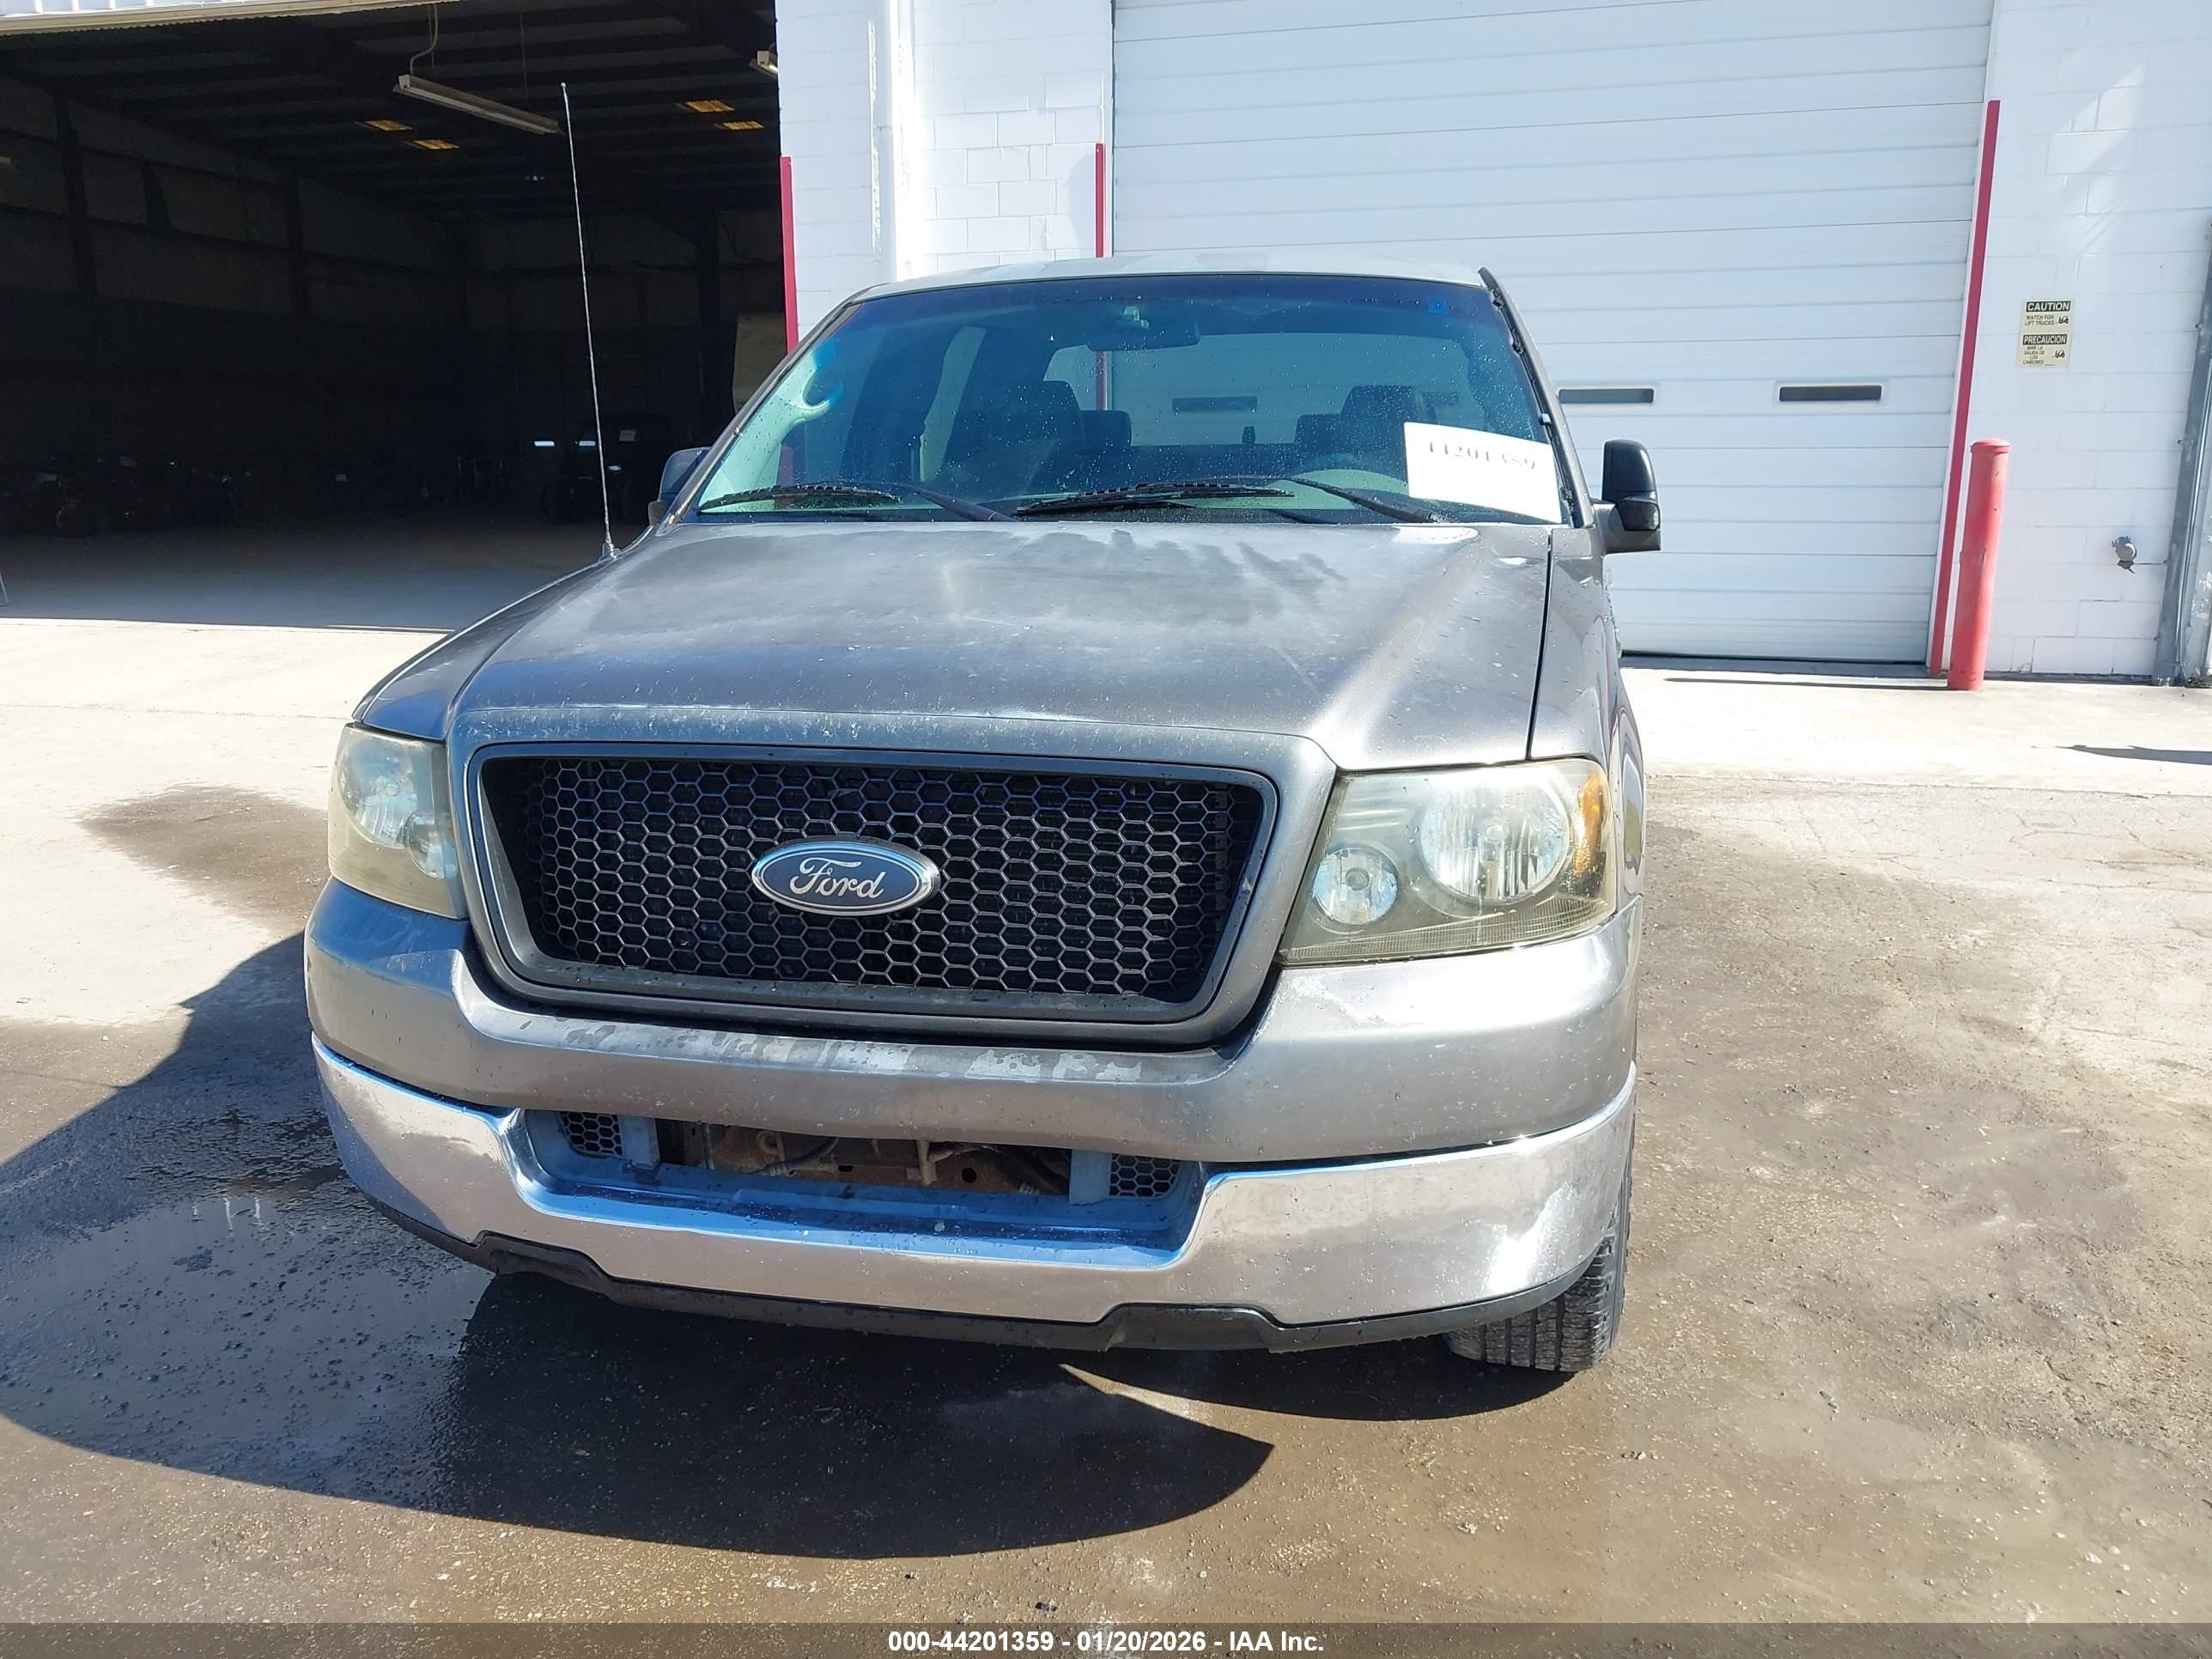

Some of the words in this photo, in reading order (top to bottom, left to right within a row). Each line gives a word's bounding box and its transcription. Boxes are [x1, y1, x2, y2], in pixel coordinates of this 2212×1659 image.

[2027, 301, 2069, 311] CAUTION
[2024, 335, 2066, 343] PRECAUCION
[789, 857, 886, 899] Ford
